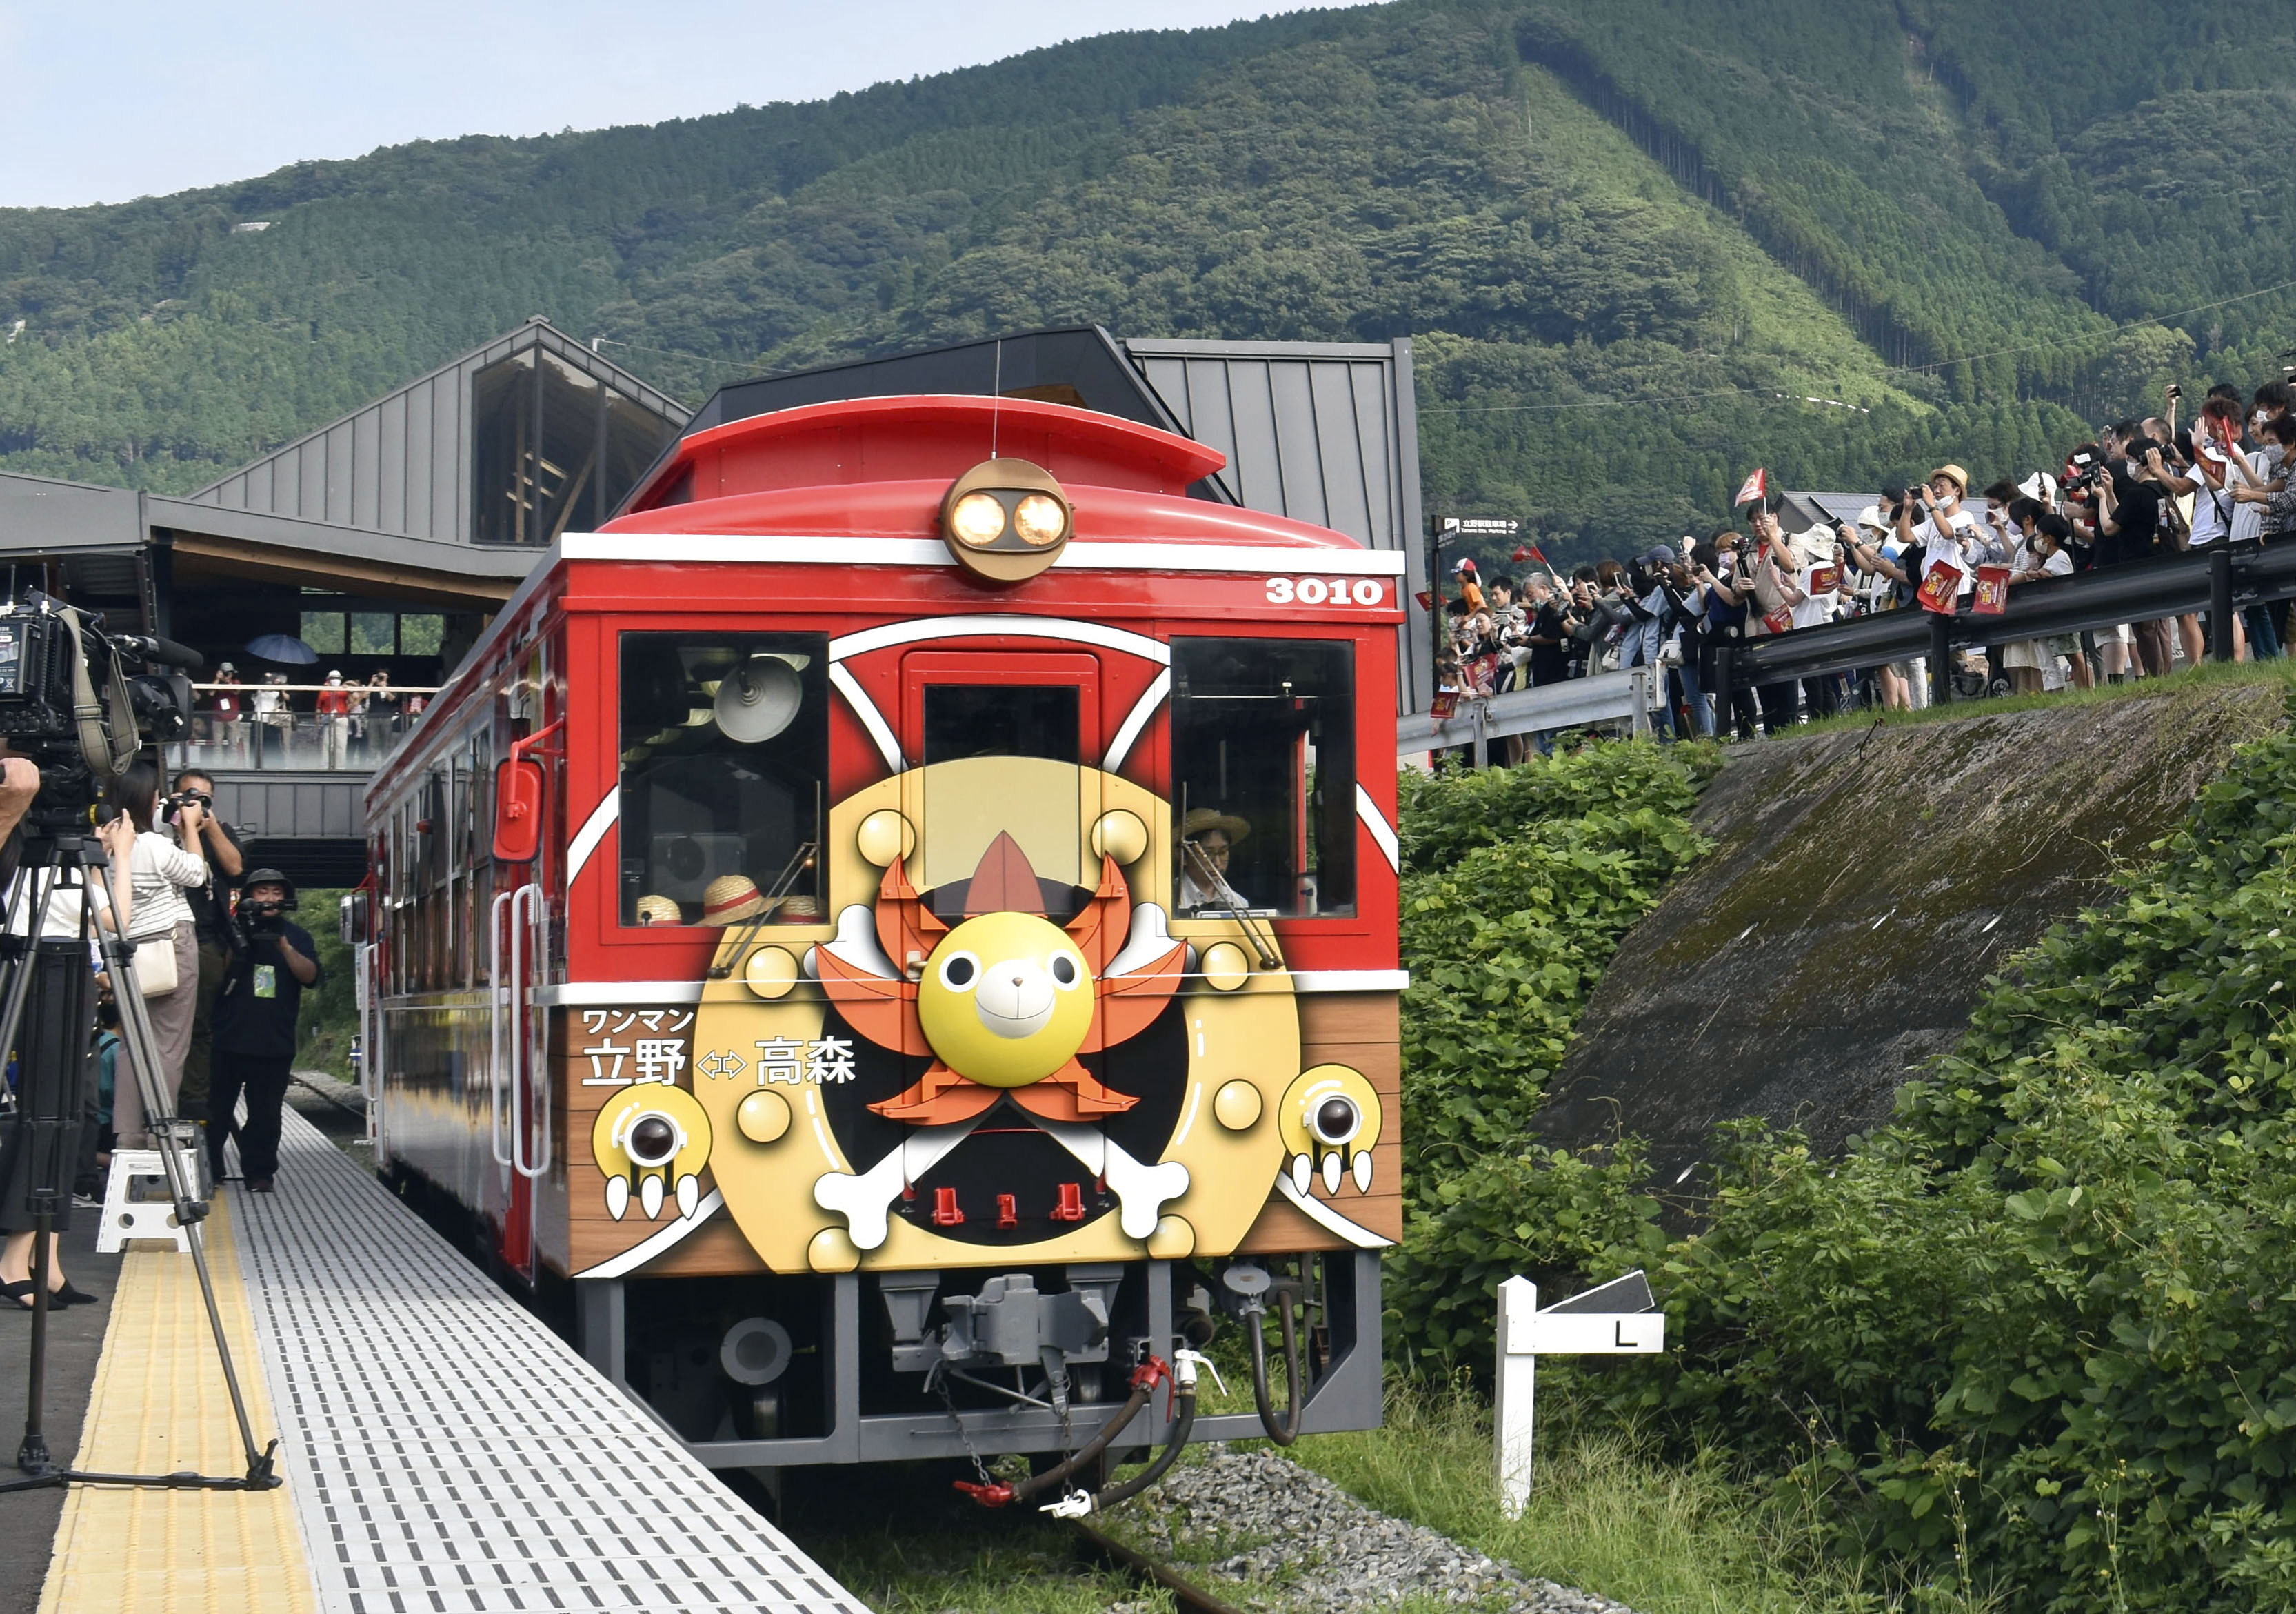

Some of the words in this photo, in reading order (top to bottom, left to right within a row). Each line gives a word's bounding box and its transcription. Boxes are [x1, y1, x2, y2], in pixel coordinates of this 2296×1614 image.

[1265, 577, 1384, 606] 3010
[583, 1009, 695, 1034] ワンマン
[581, 1038, 686, 1086] 立野
[754, 1036, 856, 1085] 高森
[1615, 1320, 1638, 1347] L
